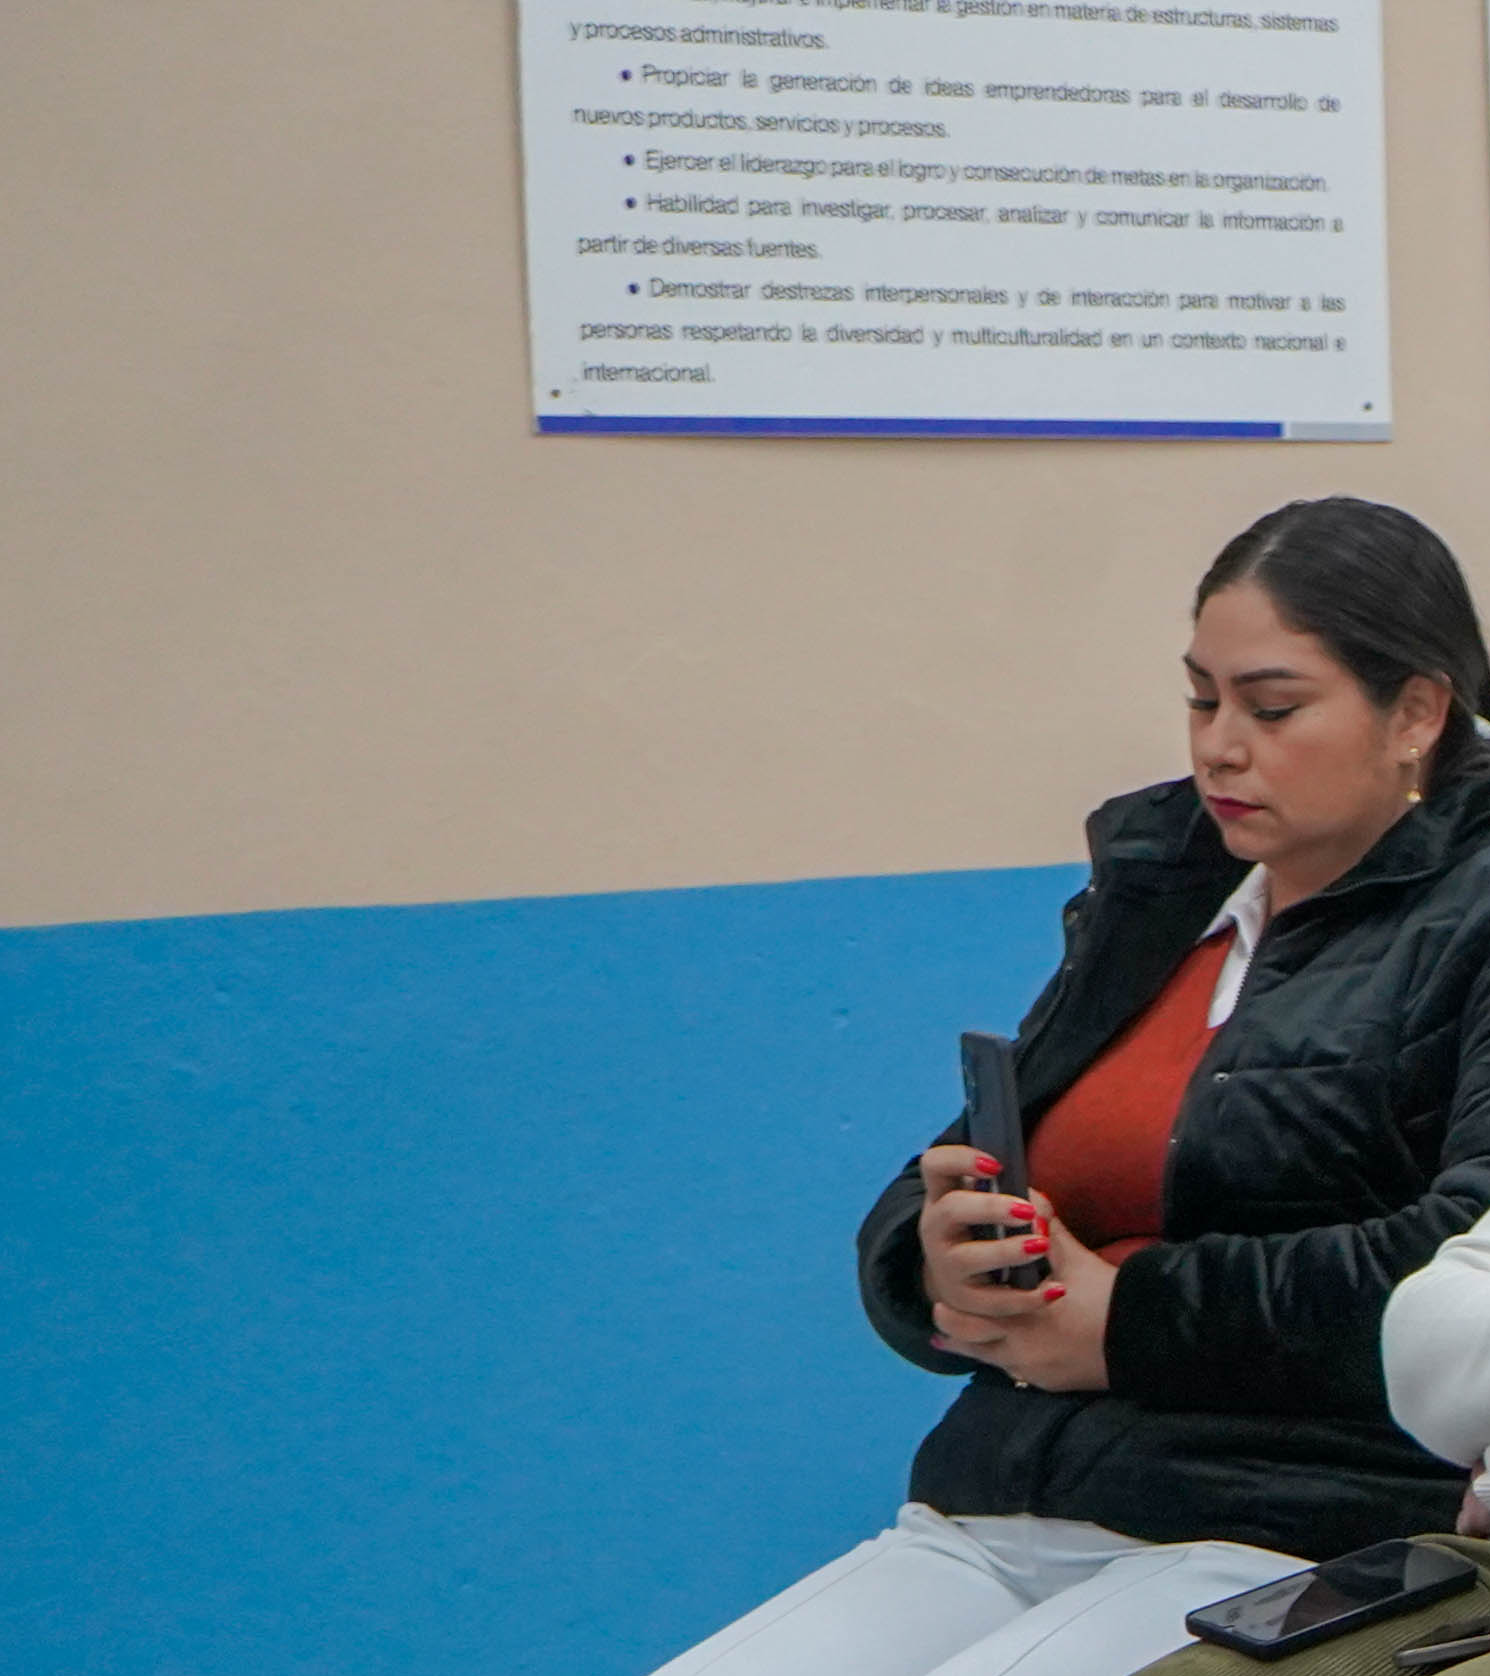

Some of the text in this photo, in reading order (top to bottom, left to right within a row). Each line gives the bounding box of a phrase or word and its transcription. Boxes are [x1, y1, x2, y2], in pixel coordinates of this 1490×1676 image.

[569, 21, 828, 47] y procesos administrativos.
[642, 64, 1339, 111] Propiciar la generación de ideas emprendedoras para el desarrollo de
[574, 106, 949, 137] nuevos productos, servicios y procesos.
[644, 148, 1328, 192] Ejercer el liderazgo para el logro y consecución de metas en la organización.
[646, 190, 1342, 231] Habilidad para investigar, procesar, analizar y comunicar la información a
[576, 232, 821, 257] partir de diversas fuentes.
[649, 276, 1345, 310] Demostrar destrezas interpersonales y de interacción para motivar a las
[580, 320, 1345, 349] personas respetando la diversidad y multiculturalidad en un contexto nacional e
[584, 359, 715, 381] internacional.
